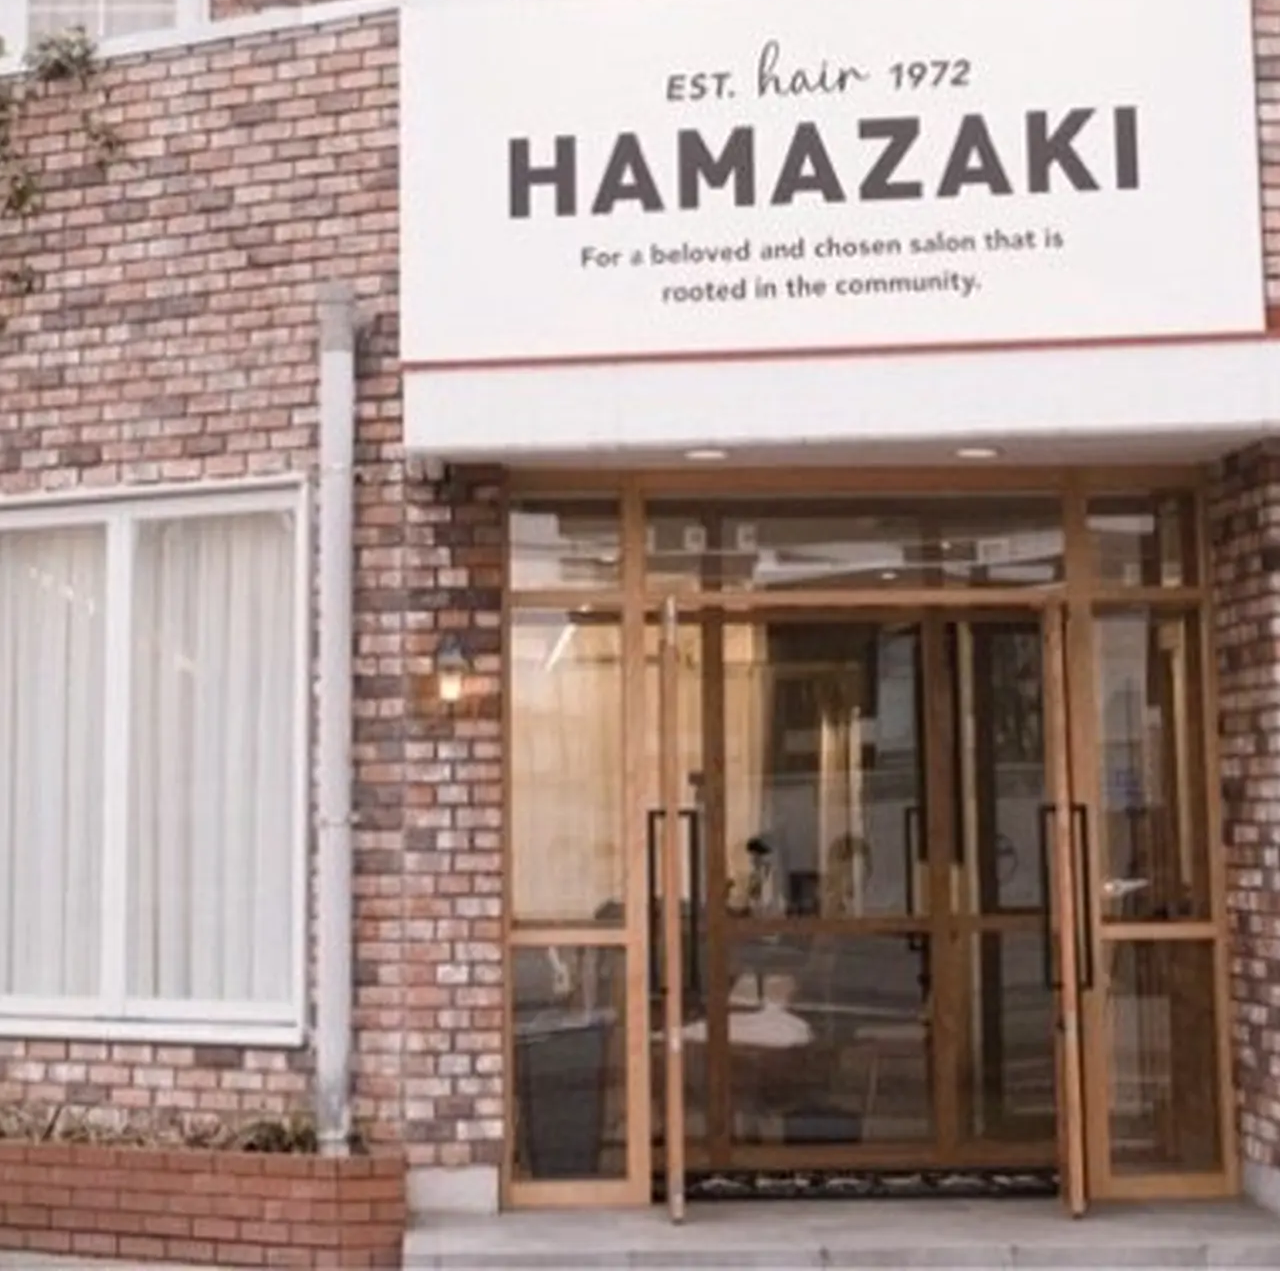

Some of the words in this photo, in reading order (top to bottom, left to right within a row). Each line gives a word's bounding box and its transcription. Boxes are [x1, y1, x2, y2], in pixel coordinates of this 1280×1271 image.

[666, 72, 735, 102] EST.
[758, 41, 868, 97] hair
[890, 59, 970, 90] 1972
[508, 105, 1139, 219] HAMAZAKI
[581, 247, 622, 267] For
[631, 250, 643, 266] a
[650, 239, 751, 264] beloved
[760, 237, 805, 260] and
[814, 236, 901, 258] chosen
[910, 231, 975, 253] salon
[984, 229, 1036, 250] that
[1045, 229, 1064, 248] is
[663, 278, 746, 302] rooted
[755, 278, 777, 298] in
[786, 275, 826, 298] the
[836, 271, 981, 297] community.
